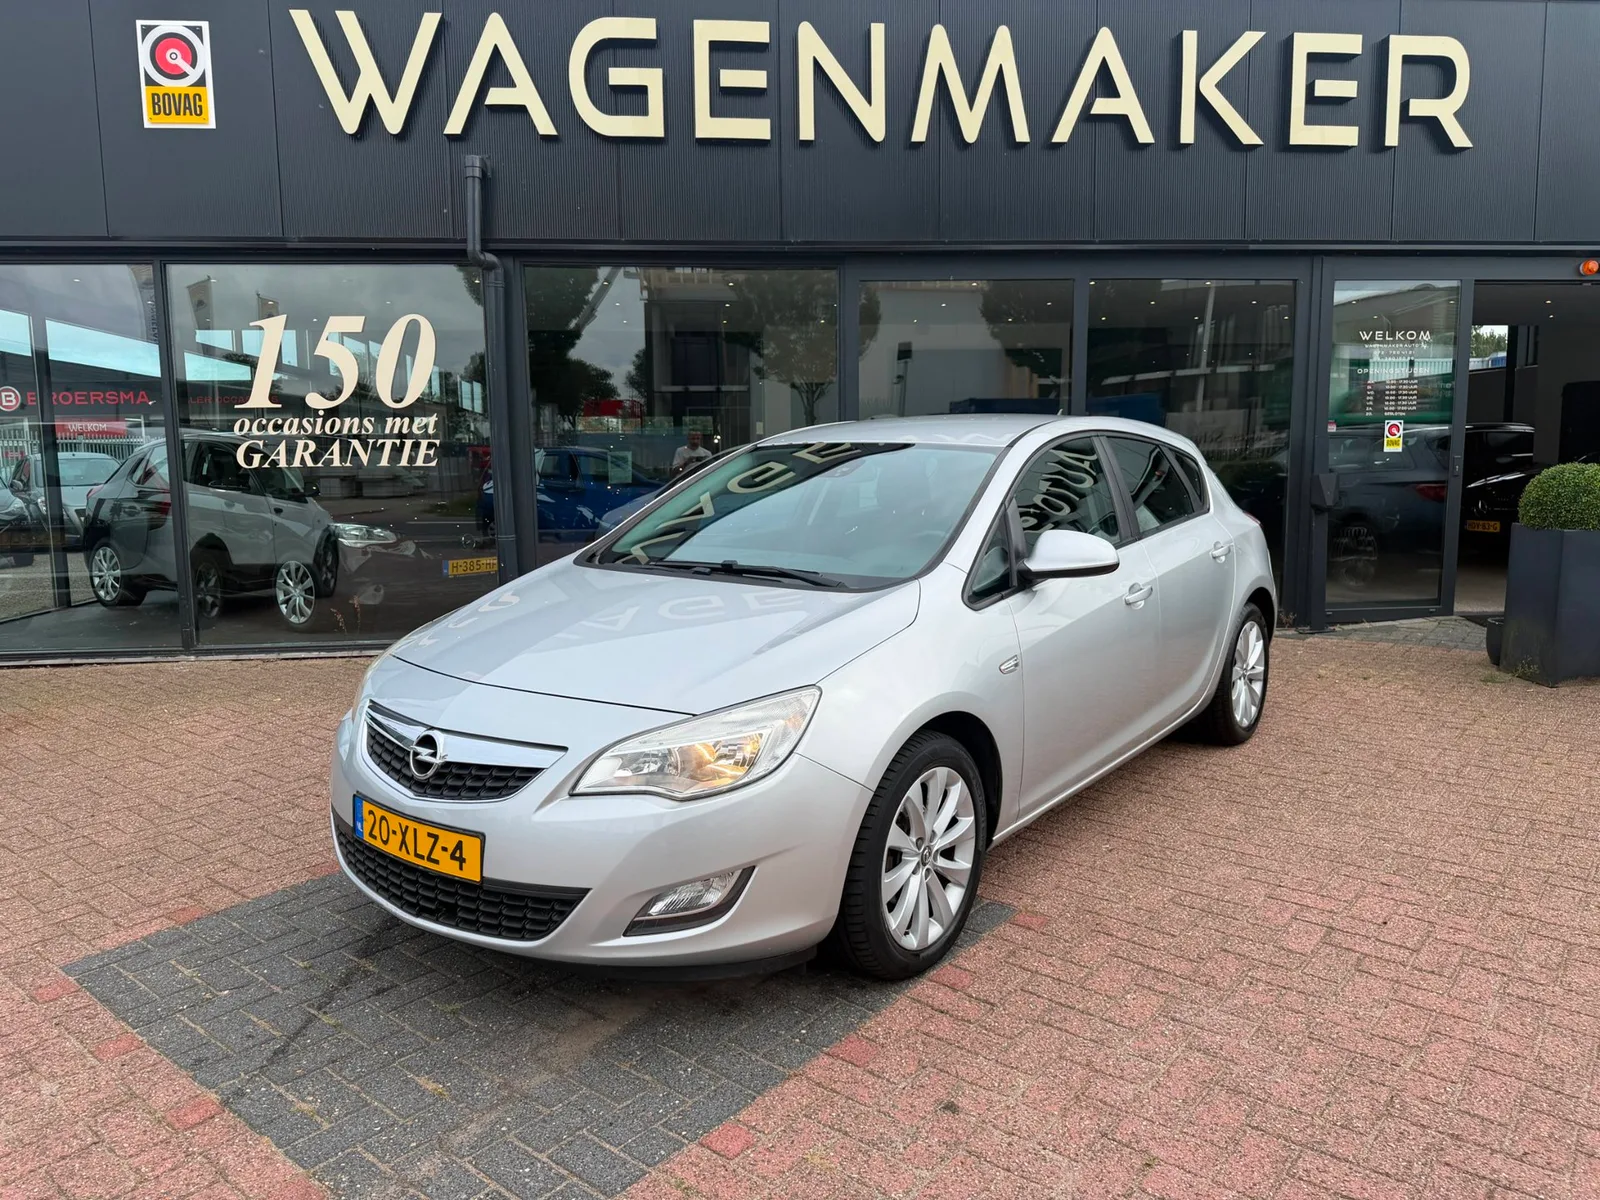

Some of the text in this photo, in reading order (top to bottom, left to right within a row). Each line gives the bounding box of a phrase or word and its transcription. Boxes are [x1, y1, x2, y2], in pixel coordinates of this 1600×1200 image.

[289, 8, 1473, 148] WAGENMAKER
[151, 92, 203, 117] BOVAG
[1359, 330, 1431, 341] WELKOM
[234, 313, 436, 409] 150
[68, 422, 107, 432] WELKOM
[233, 409, 438, 436] occasions met
[235, 438, 441, 469] GARANTIE
[367, 809, 466, 871] 20-XLZ-4
